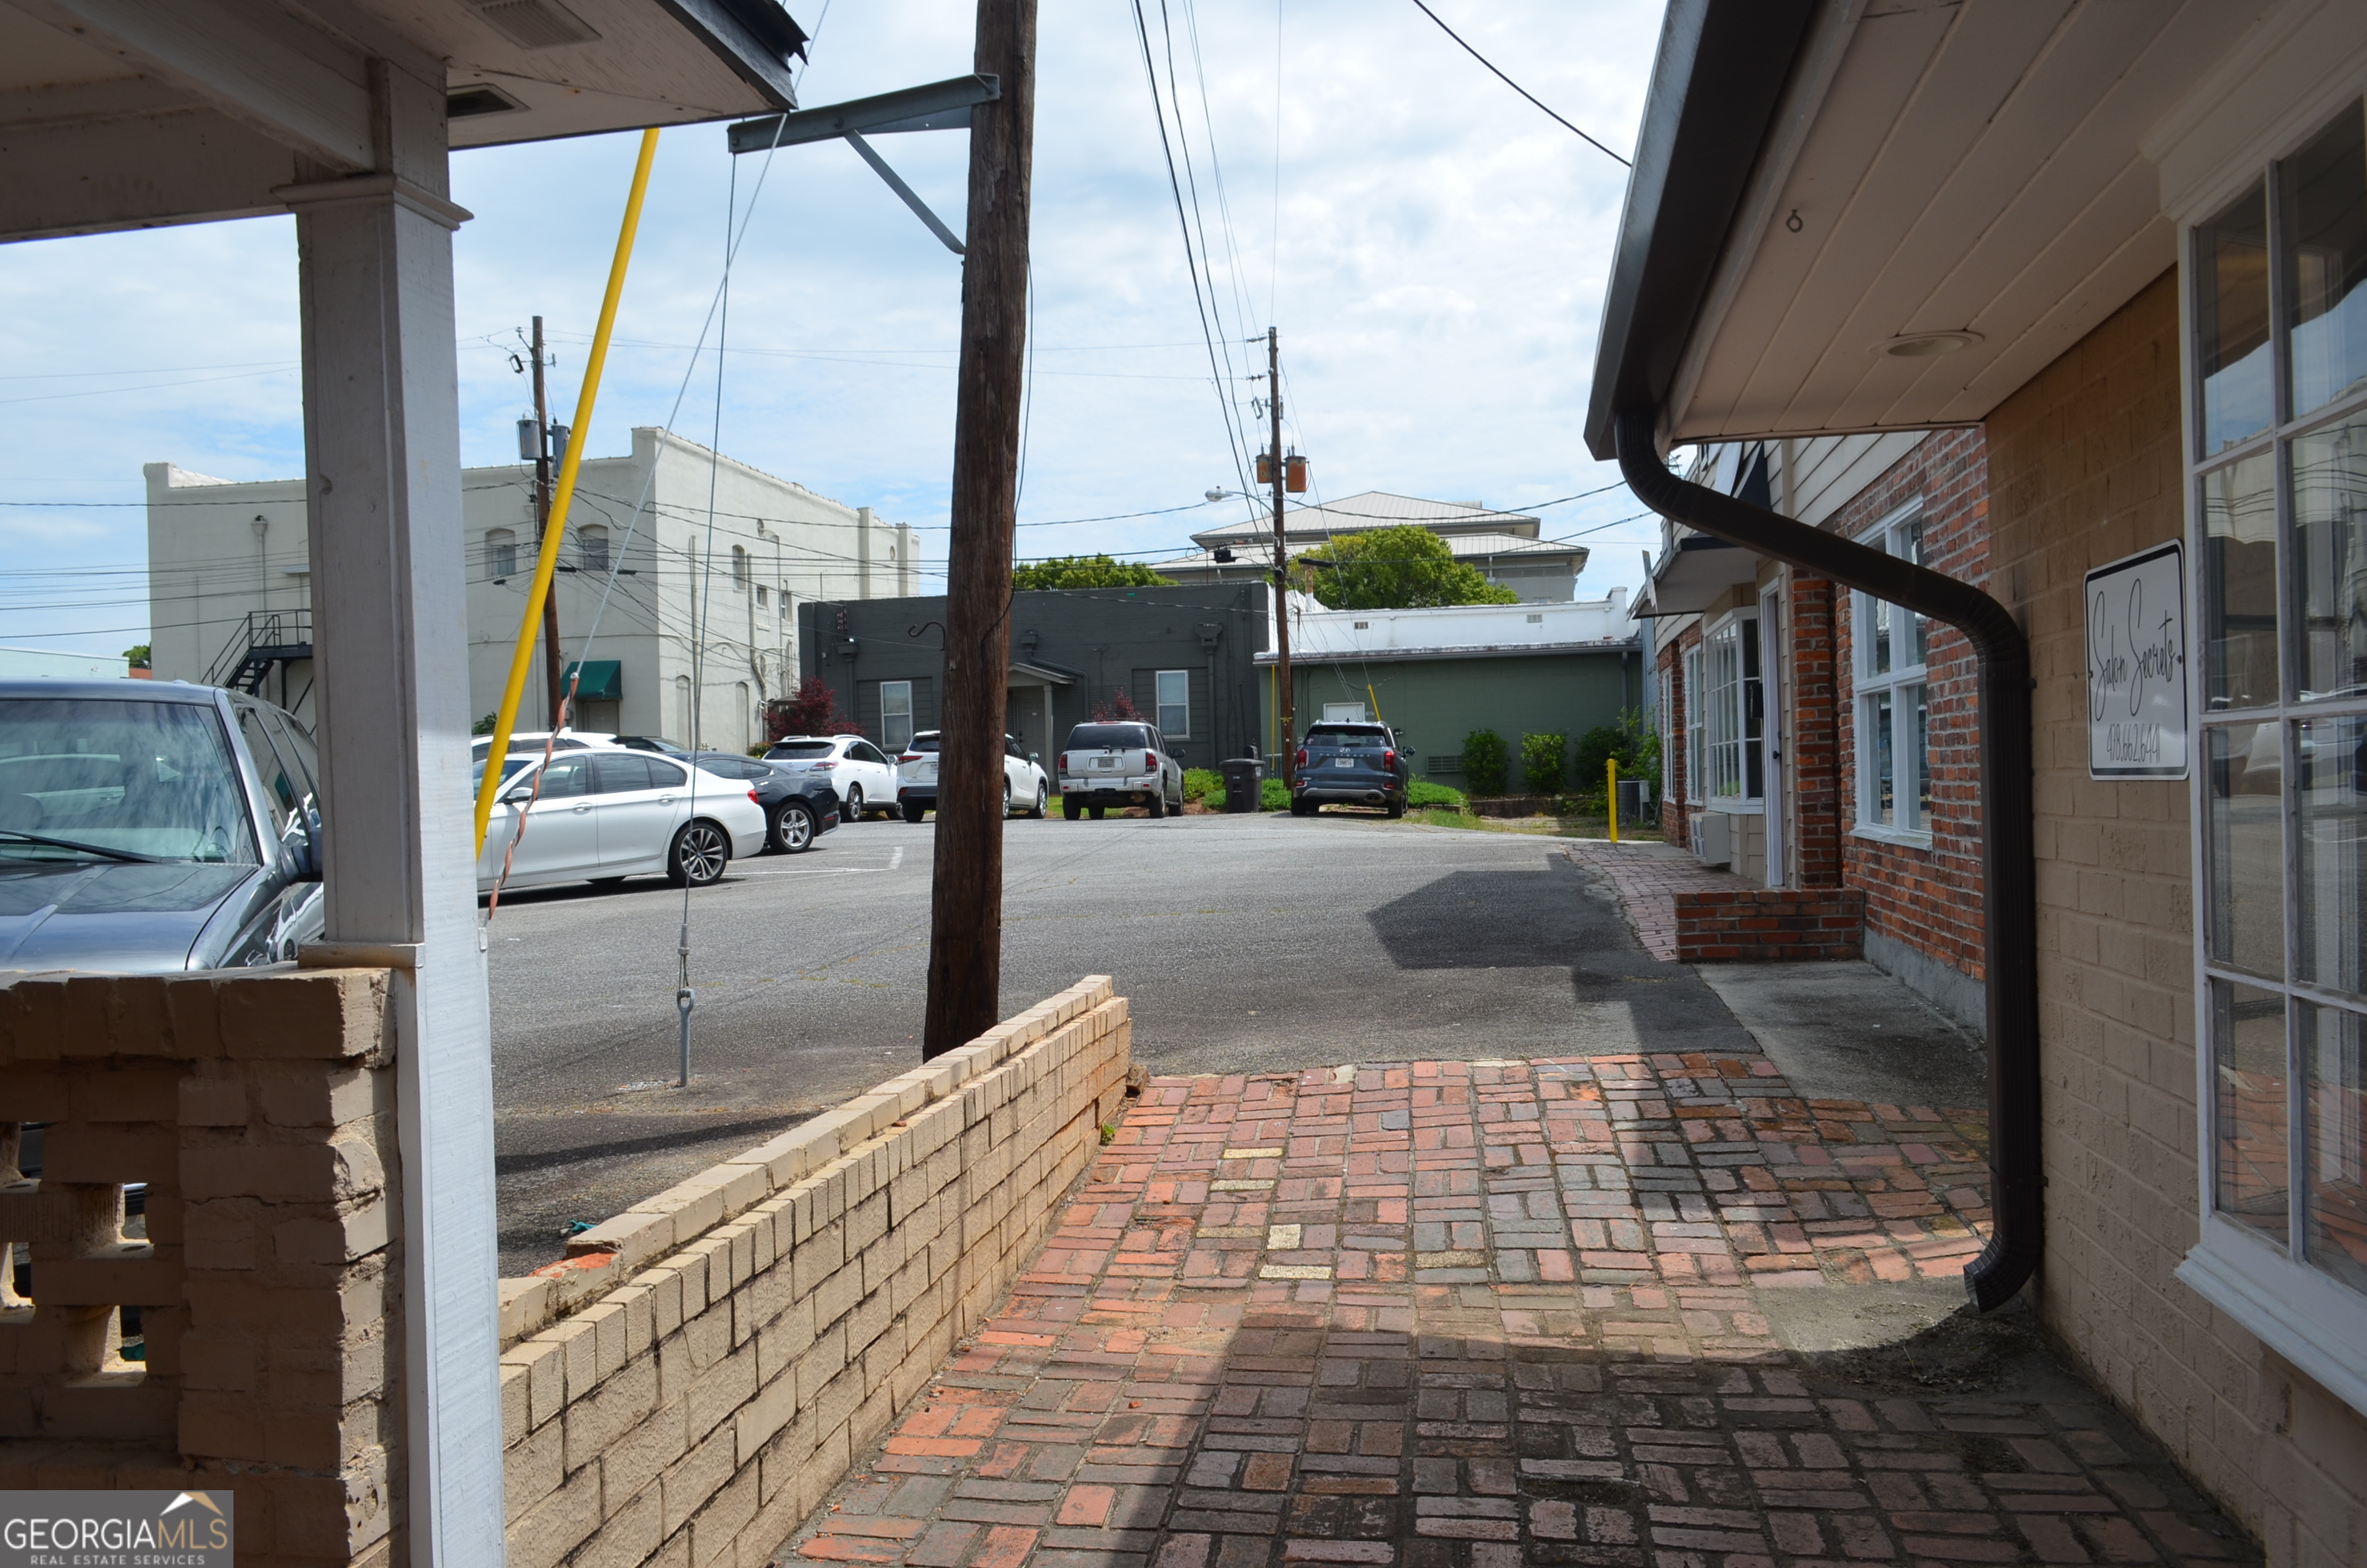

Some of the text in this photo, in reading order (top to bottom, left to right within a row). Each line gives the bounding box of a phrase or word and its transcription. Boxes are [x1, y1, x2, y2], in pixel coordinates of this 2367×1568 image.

[2093, 578, 2176, 721] Salon Secrets
[2106, 723, 2161, 764] 478.662.6441
